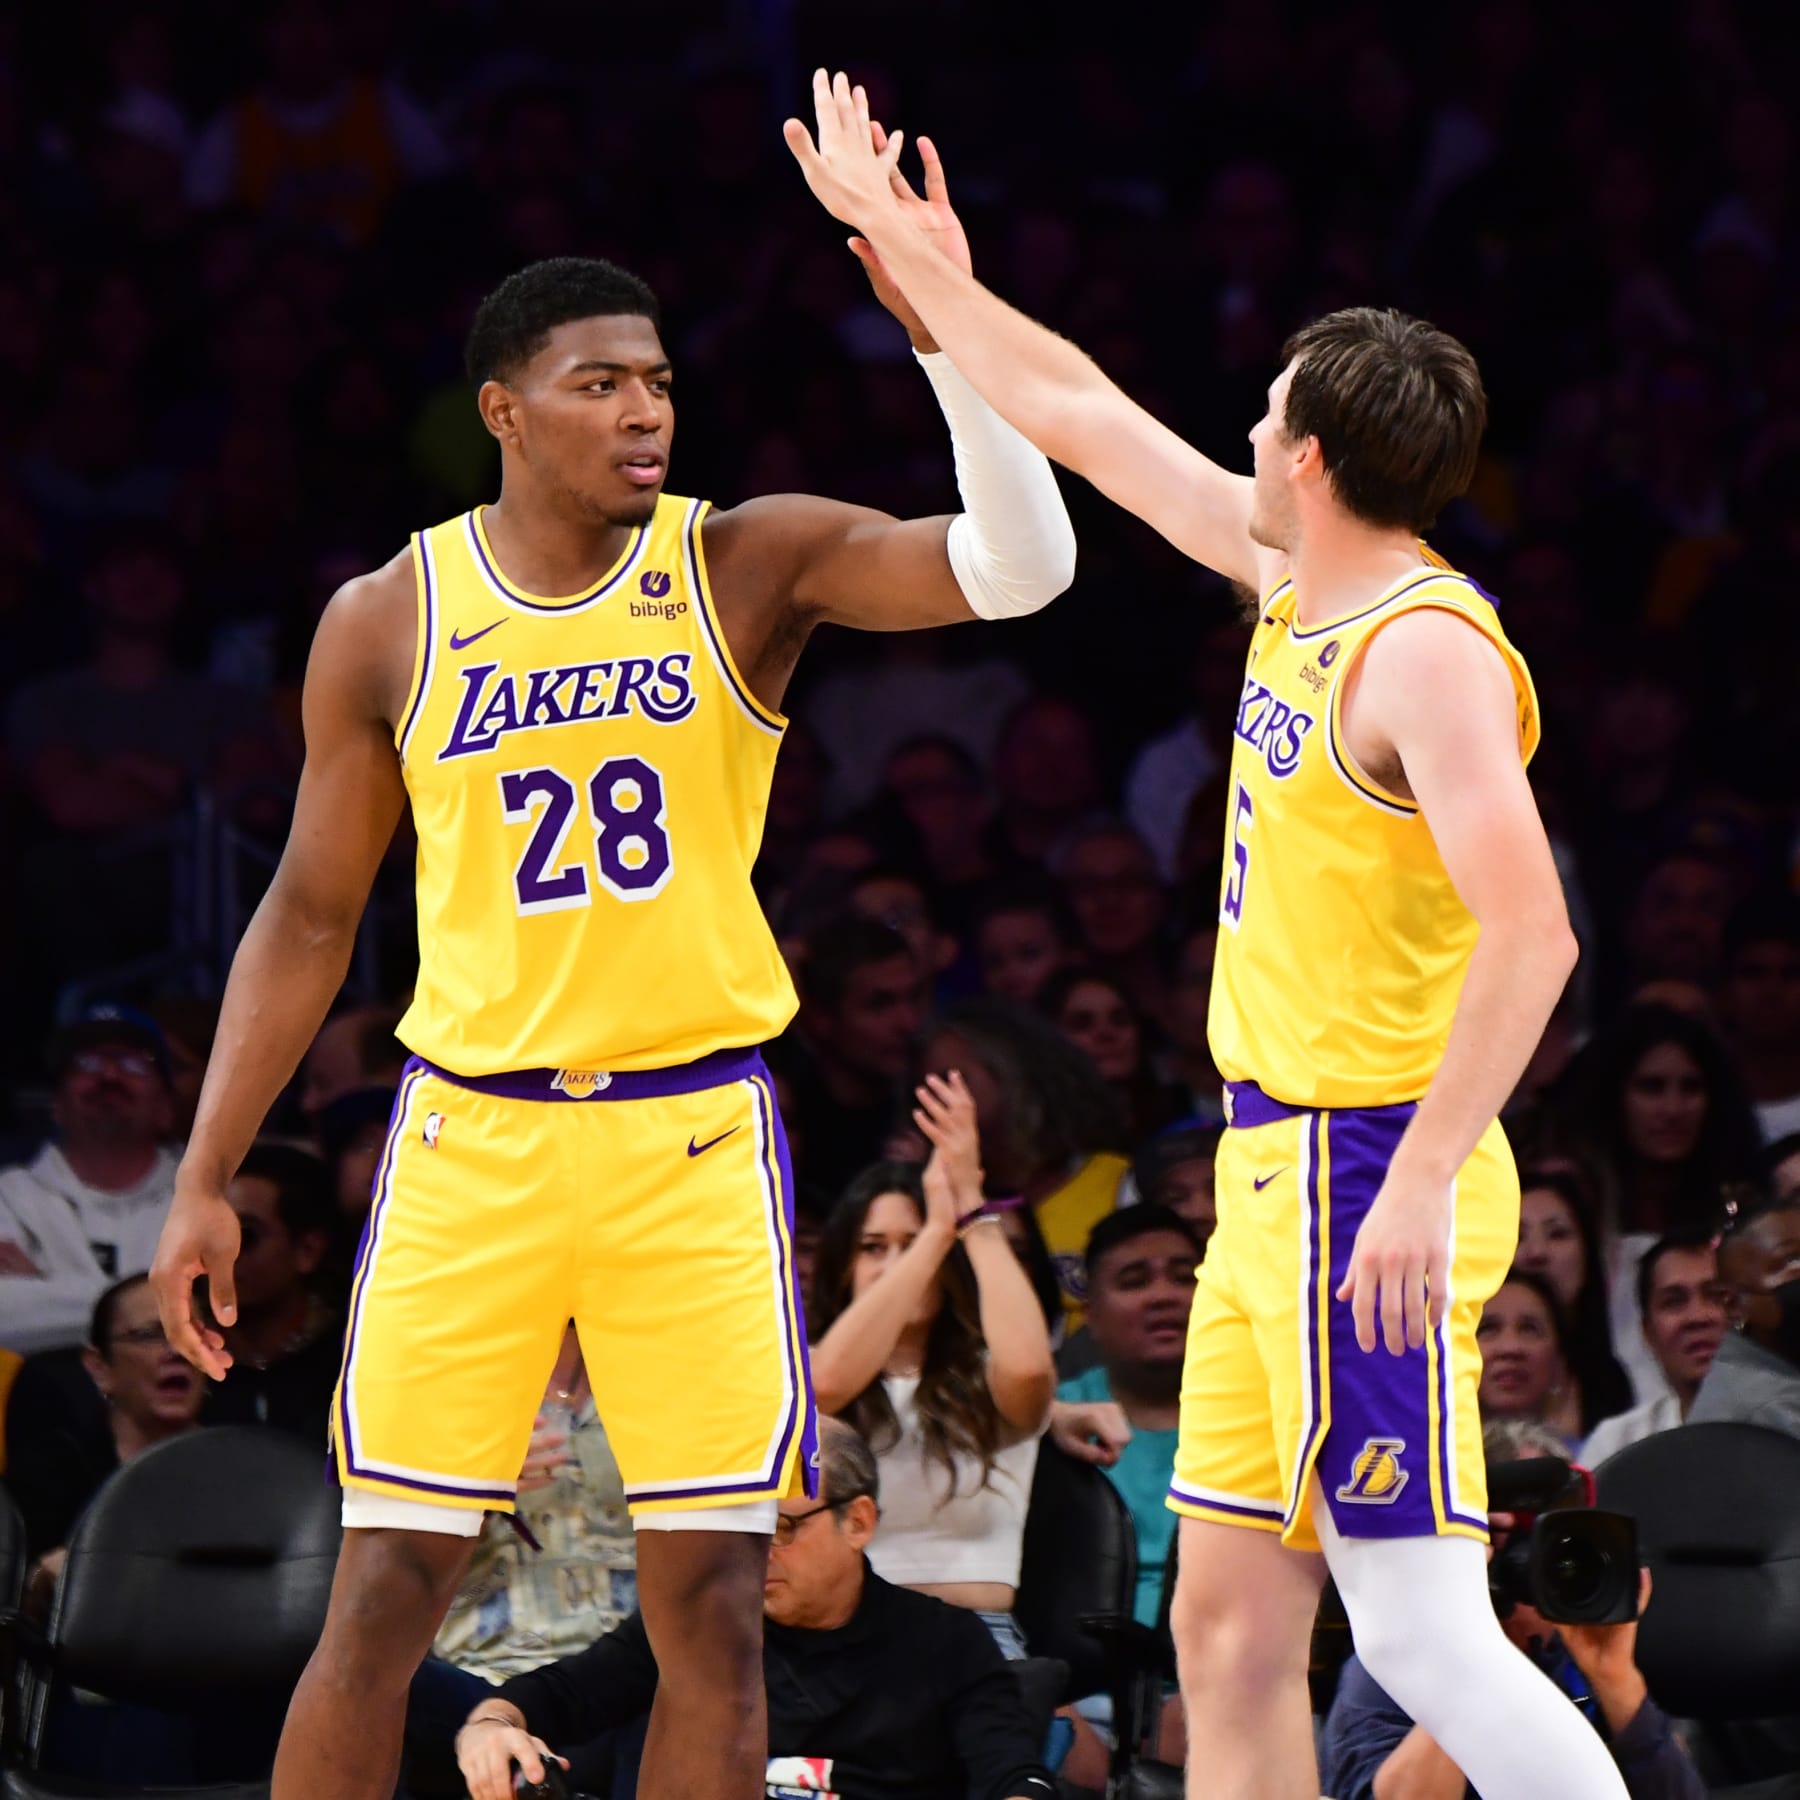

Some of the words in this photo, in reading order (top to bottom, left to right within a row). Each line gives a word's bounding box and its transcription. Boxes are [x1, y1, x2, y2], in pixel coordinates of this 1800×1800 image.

[629, 601, 688, 621] bibigo
[436, 652, 698, 764] LAKERS
[498, 754, 674, 916] 28
